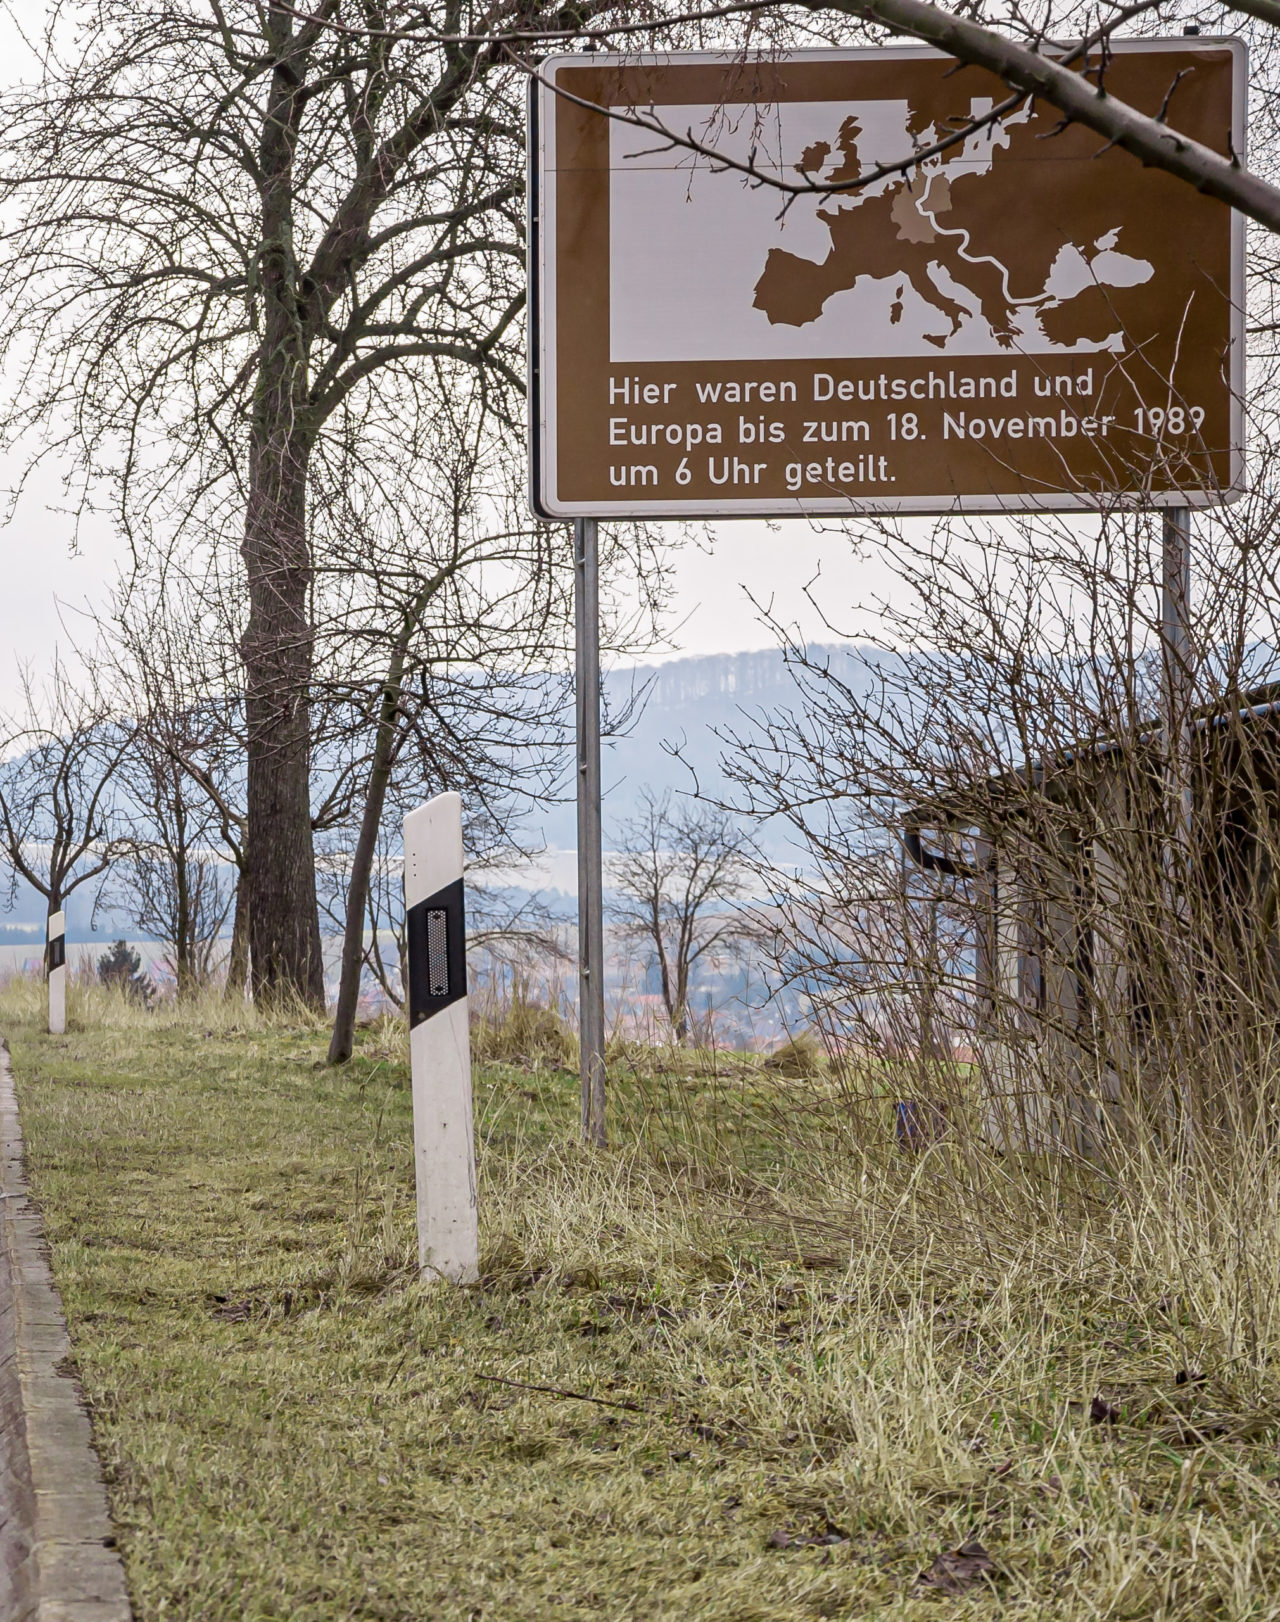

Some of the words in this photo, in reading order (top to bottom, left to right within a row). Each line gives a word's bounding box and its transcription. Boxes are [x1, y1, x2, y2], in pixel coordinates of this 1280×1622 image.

[609, 376, 678, 405] Hier
[695, 381, 797, 403] waren
[813, 369, 1017, 401] Deutschland
[1034, 367, 1094, 397] und
[609, 416, 723, 452] Europa
[739, 415, 786, 444] bis
[802, 420, 870, 442] zum
[887, 412, 927, 441] 18.
[943, 409, 1116, 440] November
[1133, 406, 1207, 436] 1989
[609, 465, 658, 486] um
[675, 457, 692, 485] 6
[708, 456, 768, 485] Uhr
[785, 454, 897, 491] geteilt.
